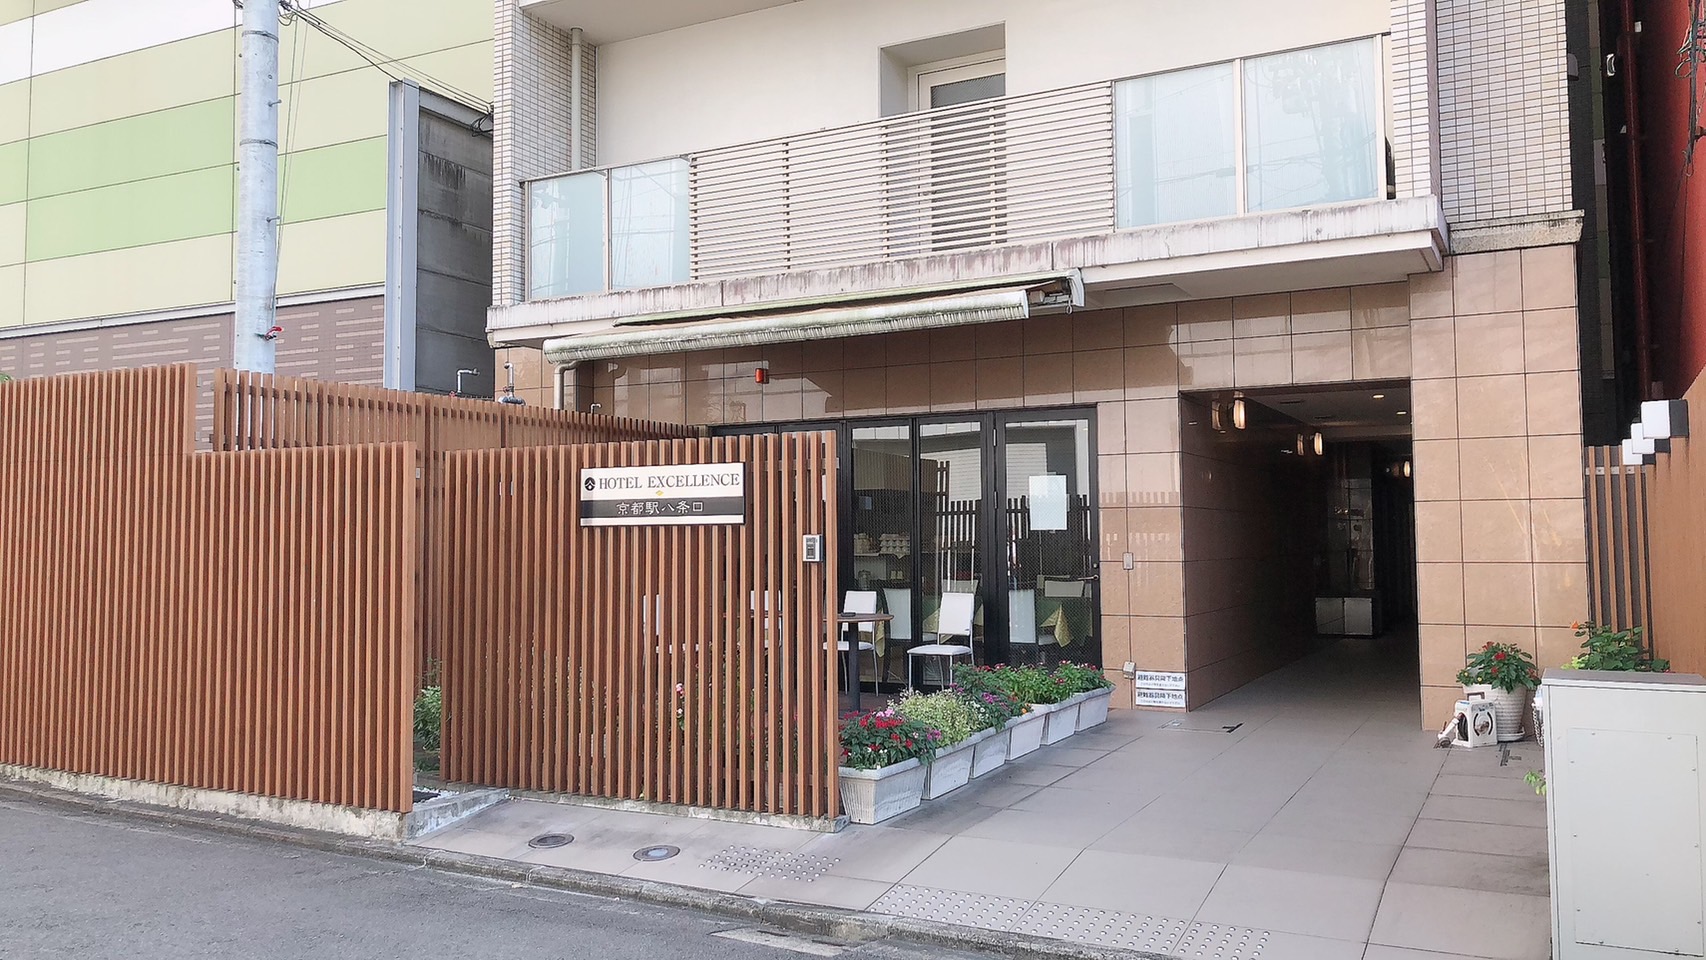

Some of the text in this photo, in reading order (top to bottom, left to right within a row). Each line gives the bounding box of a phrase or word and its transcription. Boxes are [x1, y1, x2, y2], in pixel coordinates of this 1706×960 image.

[599, 473, 740, 490] HOTEL EXCELLENCE
[616, 500, 704, 515] 京都駅八条口
